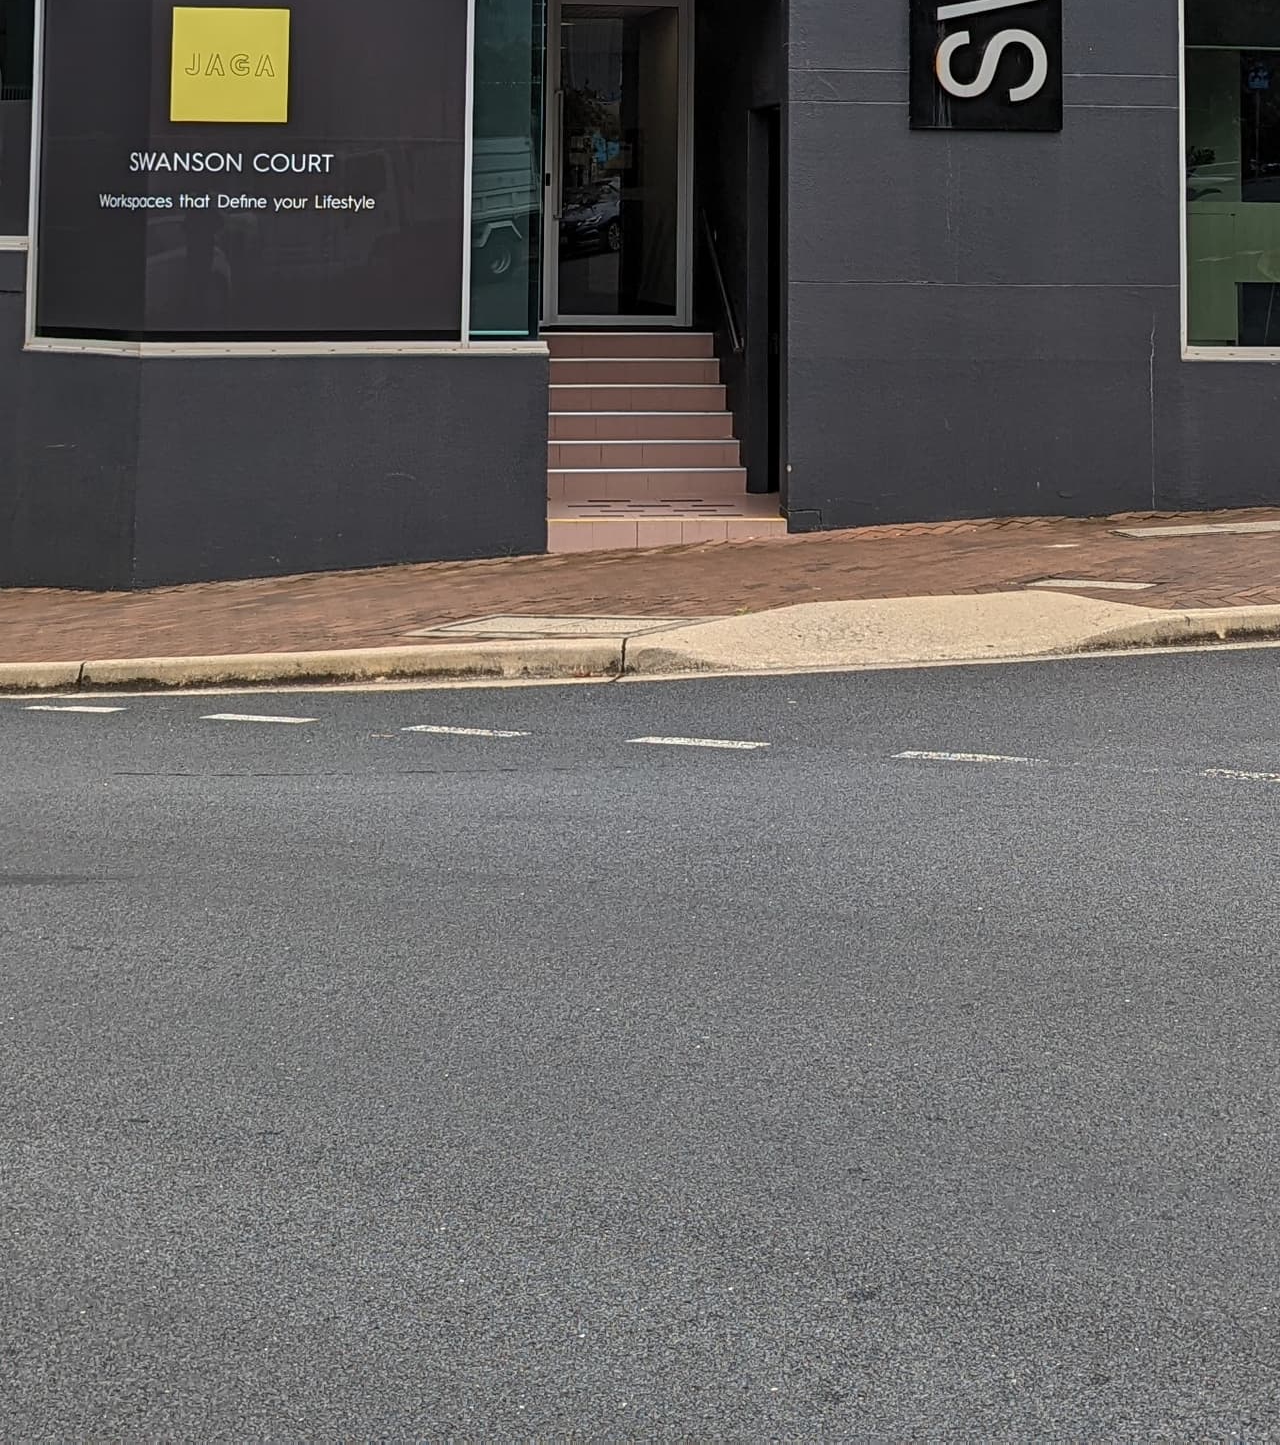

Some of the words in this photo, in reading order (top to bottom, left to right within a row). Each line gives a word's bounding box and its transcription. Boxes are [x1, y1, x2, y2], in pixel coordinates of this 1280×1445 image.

[184, 52, 276, 77] JAGA
[128, 152, 243, 173] SWANSON
[253, 153, 334, 174] COURT
[98, 194, 173, 211] Workspaces
[179, 194, 211, 209] that
[217, 194, 268, 209] Define
[273, 196, 309, 212] your
[314, 194, 376, 212] Lifestyle
